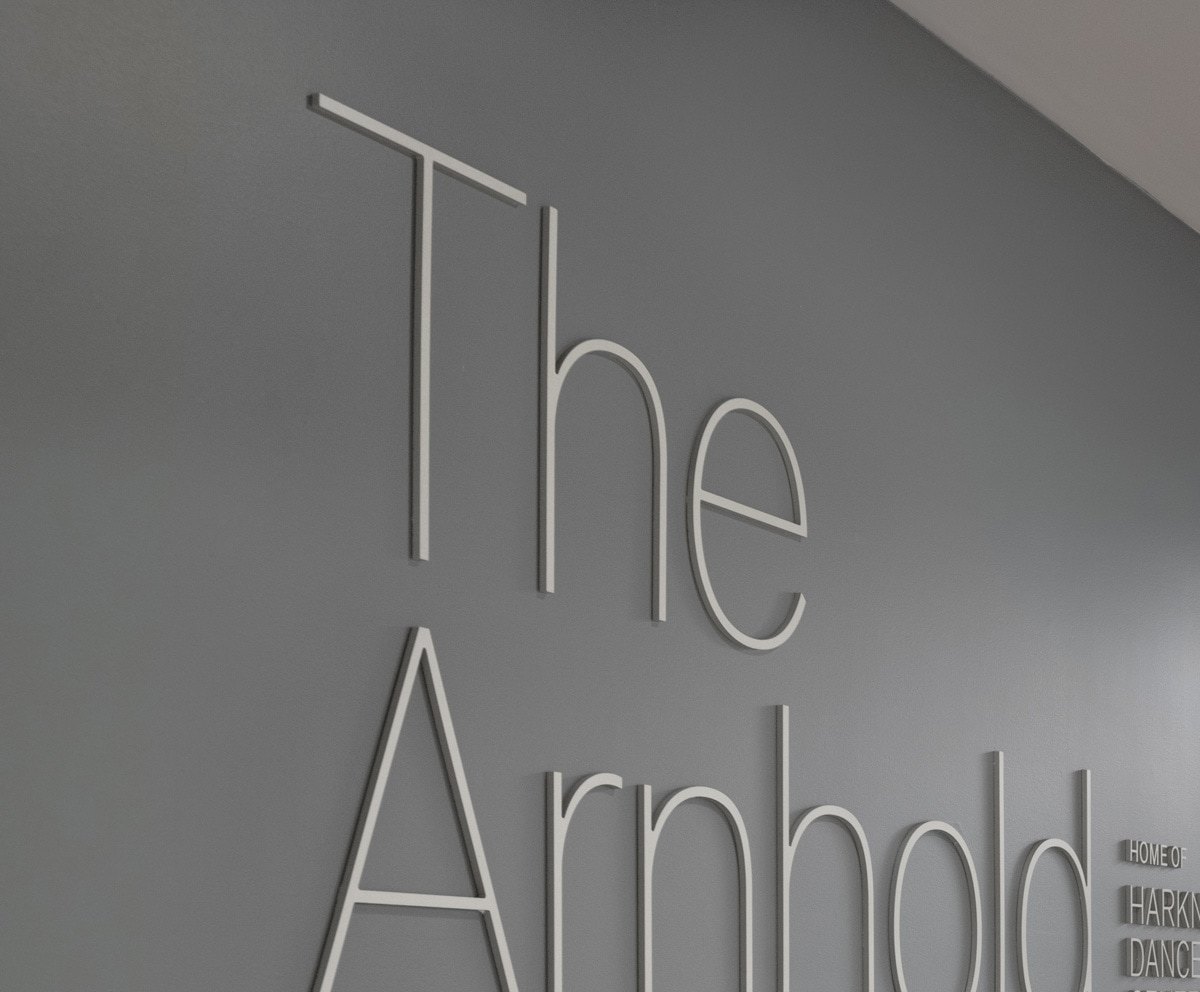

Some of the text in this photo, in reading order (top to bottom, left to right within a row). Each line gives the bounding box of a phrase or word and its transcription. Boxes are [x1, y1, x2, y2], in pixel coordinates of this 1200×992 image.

[308, 92, 808, 650] The
[1127, 839, 1187, 869] HOME OF
